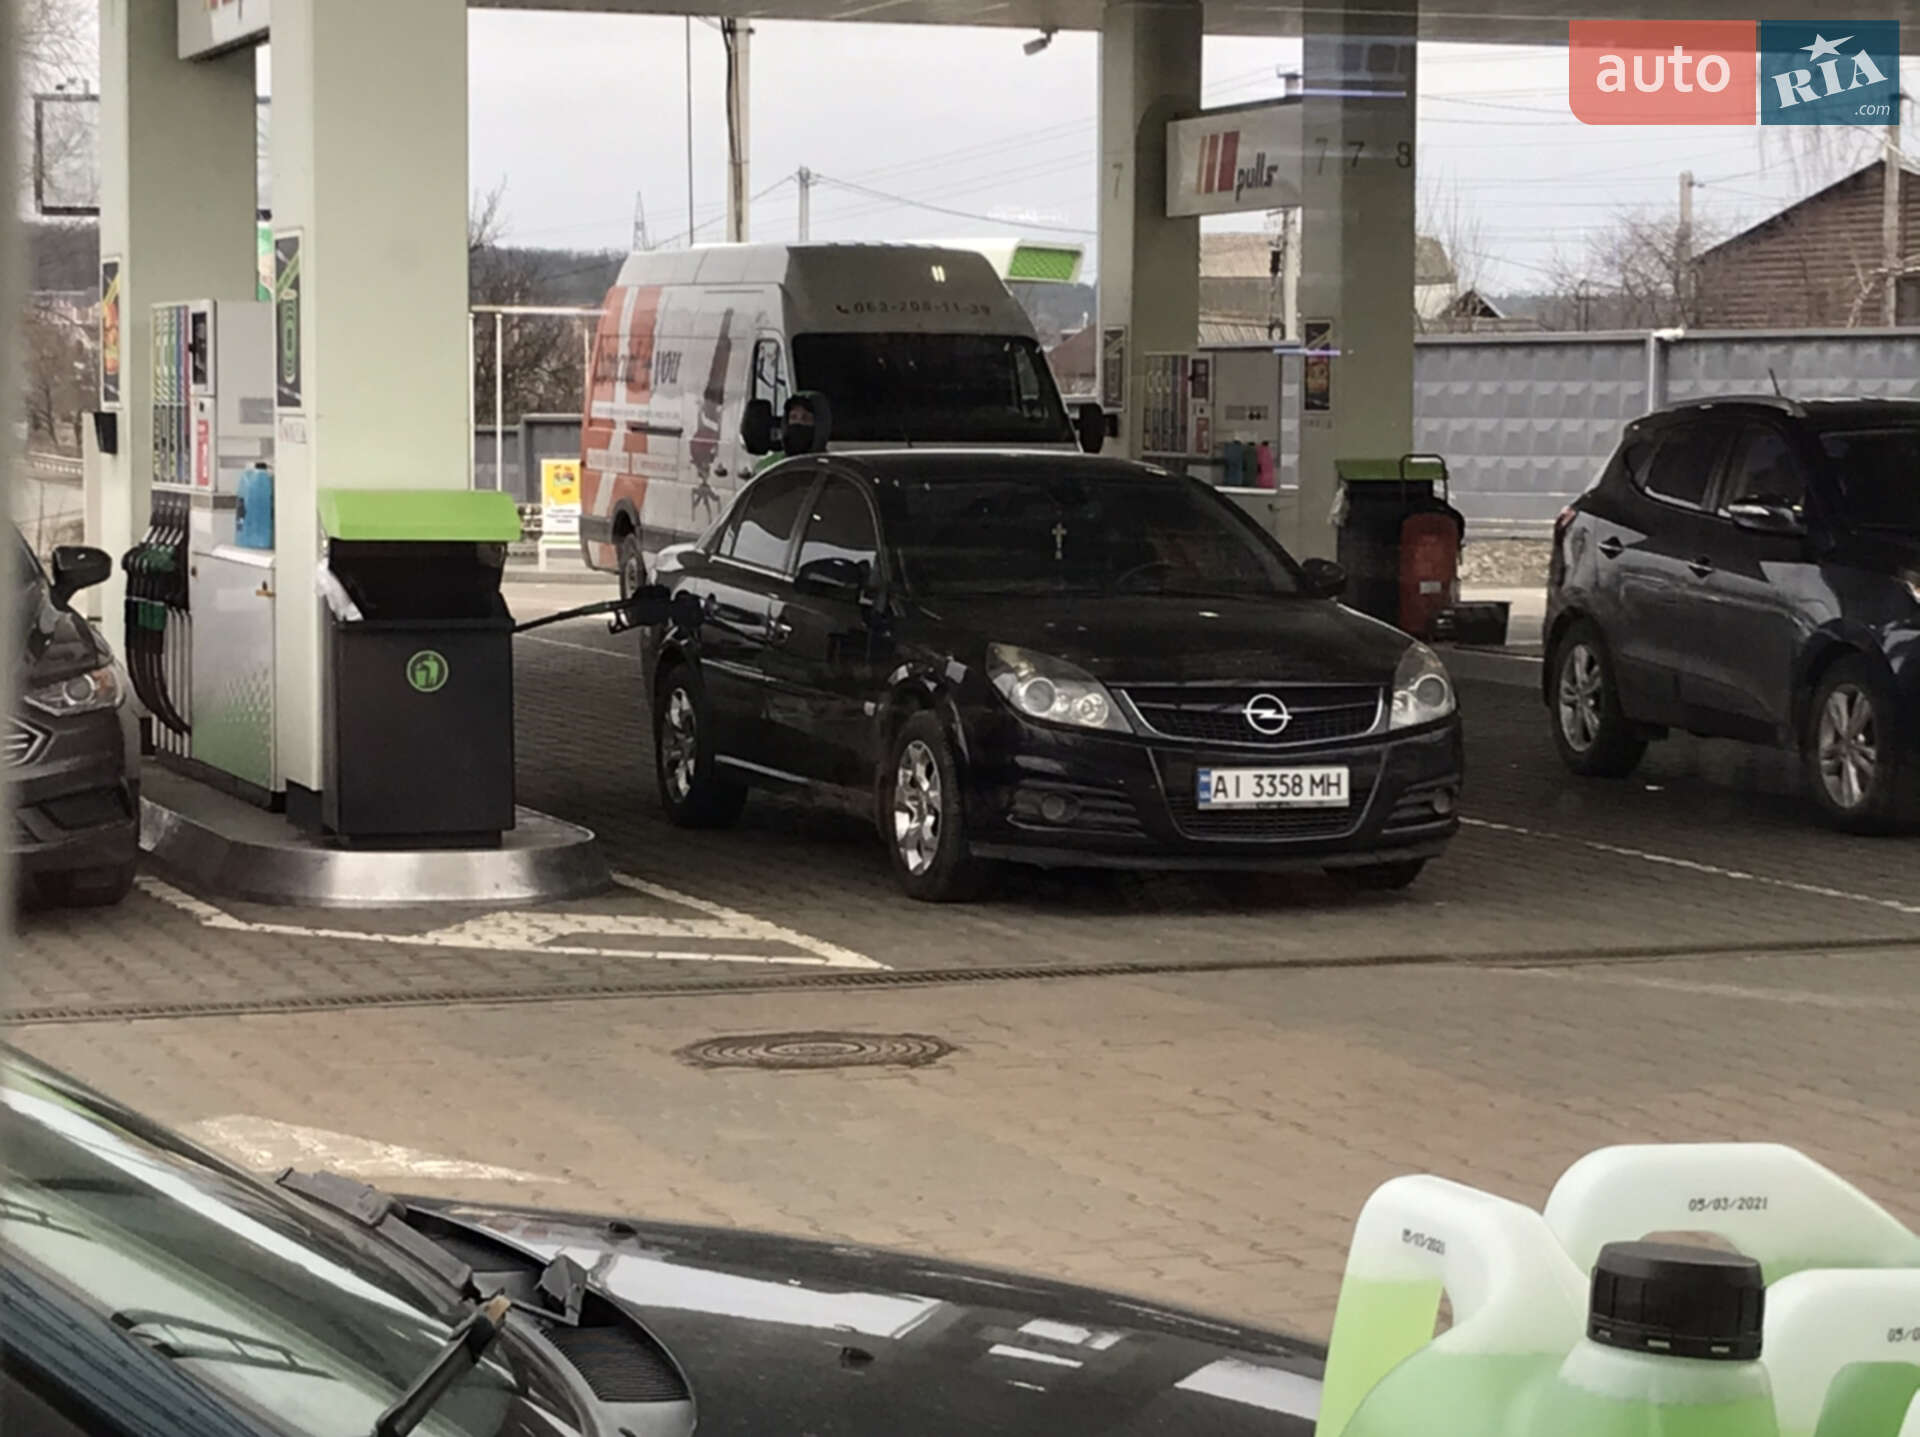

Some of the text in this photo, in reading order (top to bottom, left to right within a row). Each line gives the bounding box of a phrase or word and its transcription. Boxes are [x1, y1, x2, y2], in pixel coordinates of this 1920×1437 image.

[1347, 140, 1365, 169] 7
[1235, 152, 1279, 202] pulls
[1213, 774, 1241, 799] AI
[1252, 773, 1304, 798] 3358
[1309, 773, 1342, 797] MH
[1688, 1196, 1769, 1213] 05/03/2021
